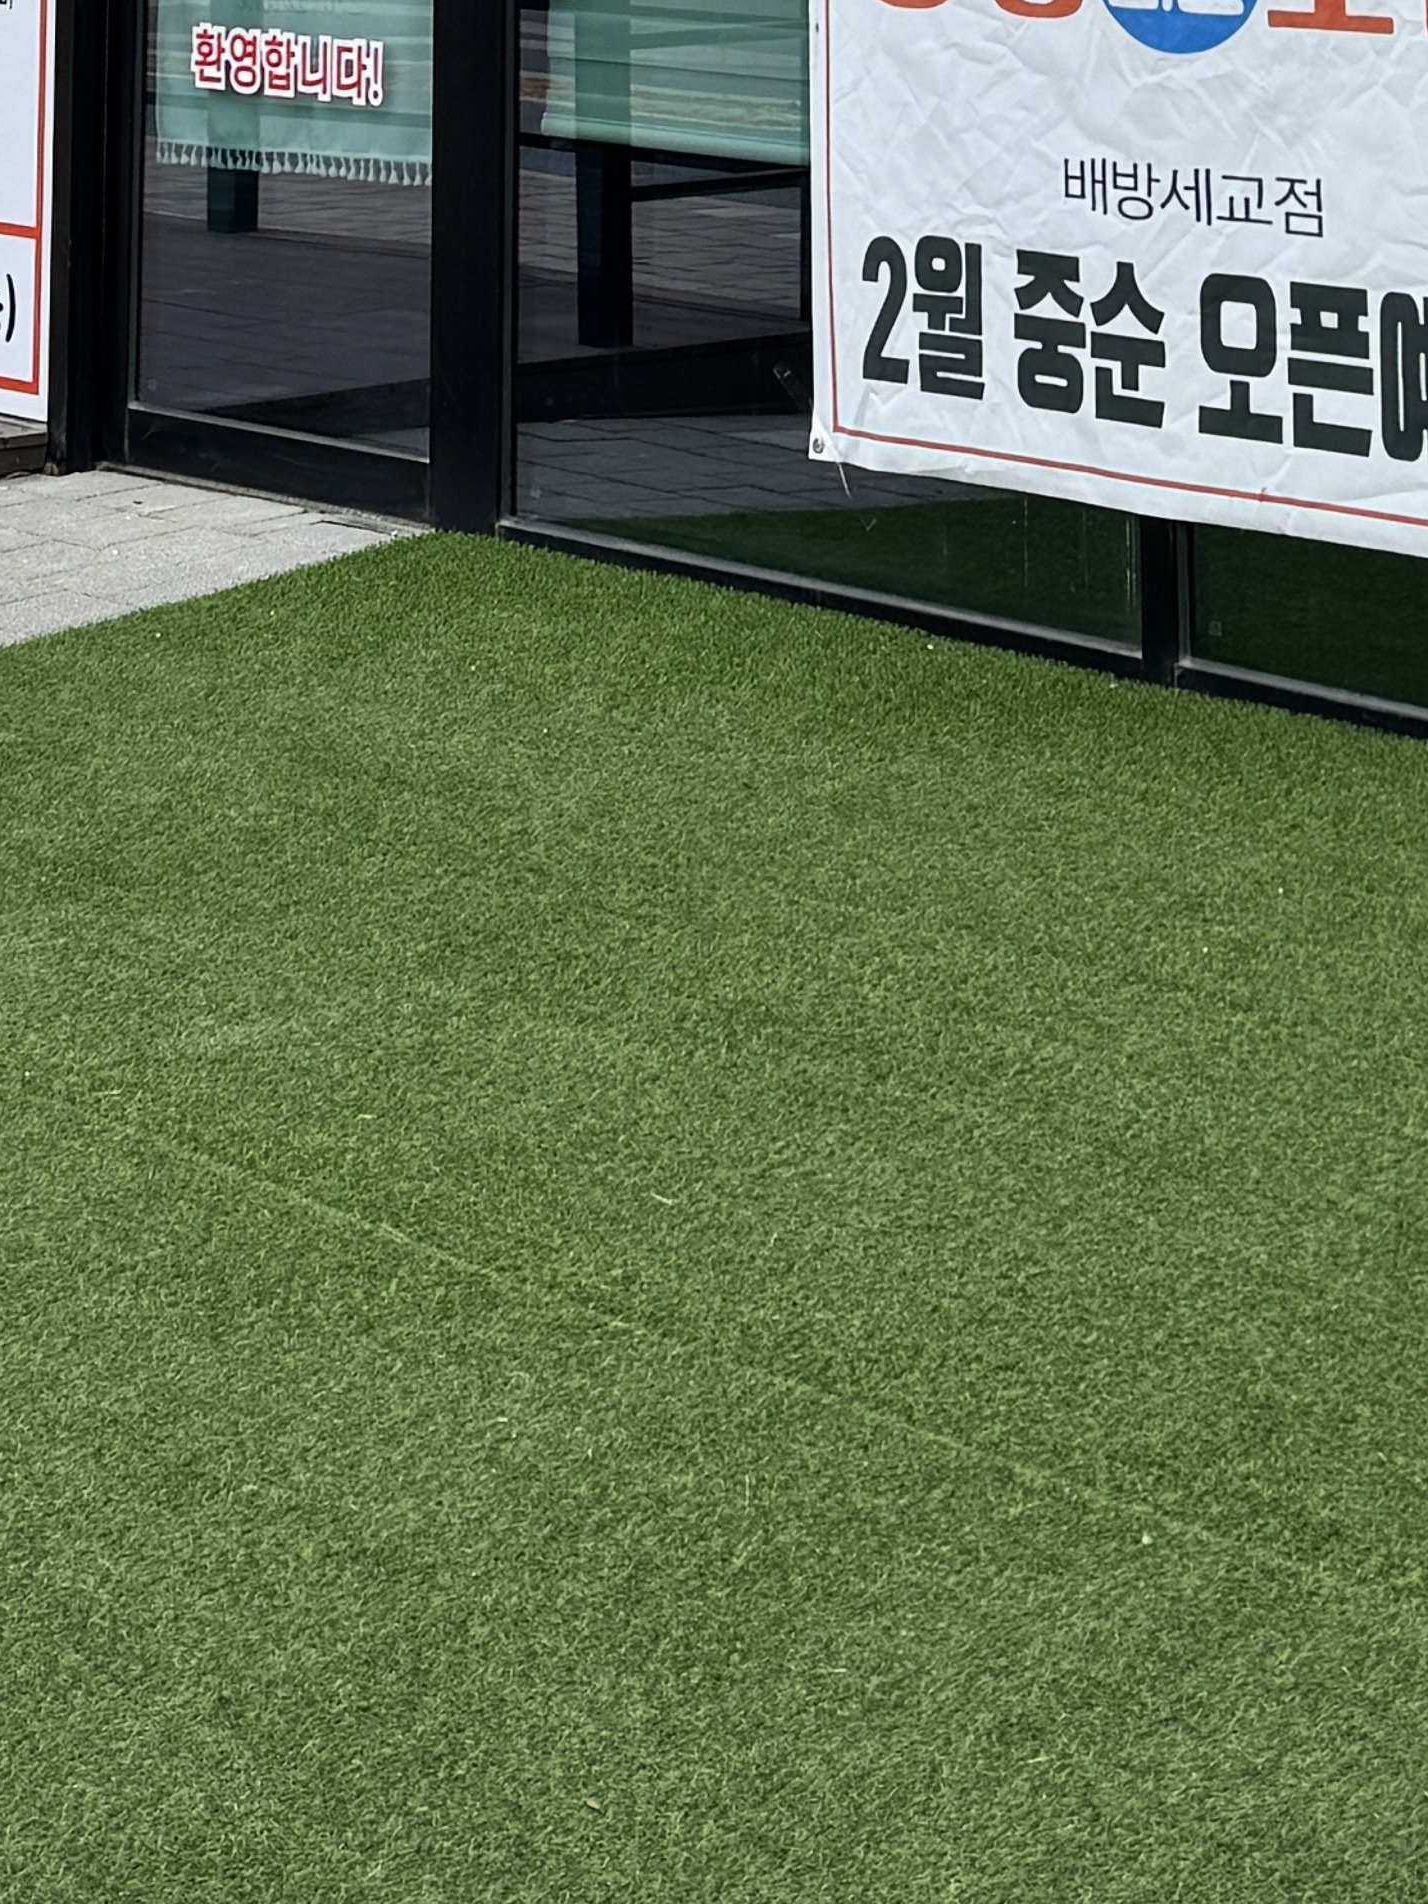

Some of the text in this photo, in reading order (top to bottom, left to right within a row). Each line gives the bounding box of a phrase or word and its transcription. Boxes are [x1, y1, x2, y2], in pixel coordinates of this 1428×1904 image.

[191, 21, 385, 108] 환영합니다!
[1059, 156, 1328, 242] 배방세교점
[860, 232, 985, 402] 2월
[1014, 248, 1167, 429] 중순
